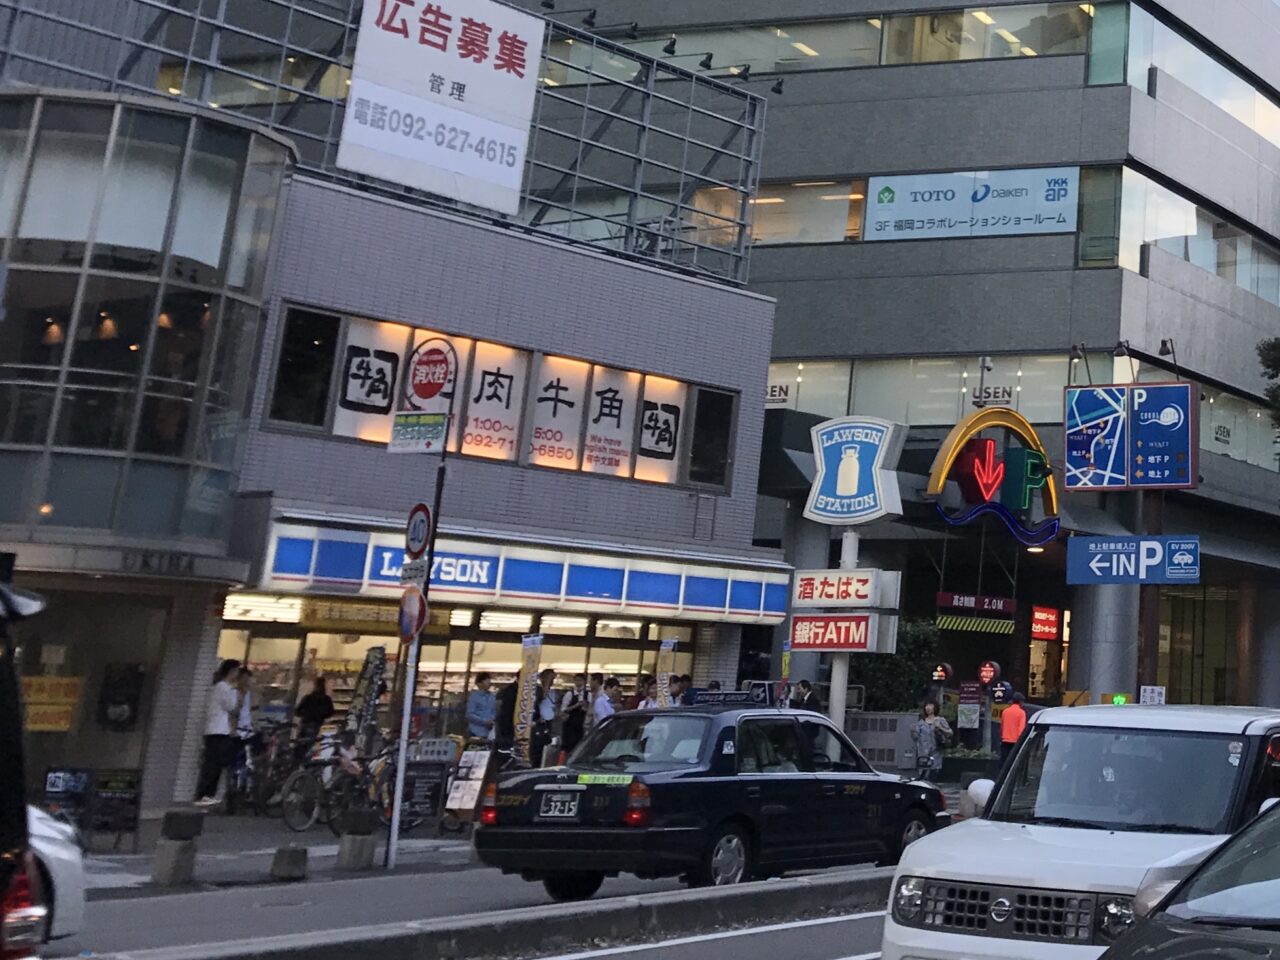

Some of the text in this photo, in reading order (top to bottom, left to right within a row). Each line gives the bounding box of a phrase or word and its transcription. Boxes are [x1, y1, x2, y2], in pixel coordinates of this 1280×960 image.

[428, 72, 466, 102] 管理
[1046, 177, 1068, 188] YKK
[910, 189, 955, 203] TOTO
[875, 213, 1067, 232] 3F 福岡コラボレーションショールーム
[350, 358, 389, 401] 牛角
[414, 363, 447, 384] 消火栓
[972, 386, 1012, 400] USEN
[1133, 389, 1147, 411] P
[644, 411, 673, 448] 牛角
[822, 428, 882, 447] LAWSON
[816, 492, 876, 513] STATION
[1112, 541, 1163, 579] IN P
[798, 576, 869, 600] 酒・たばこ
[794, 620, 866, 644] 銀行ATM
